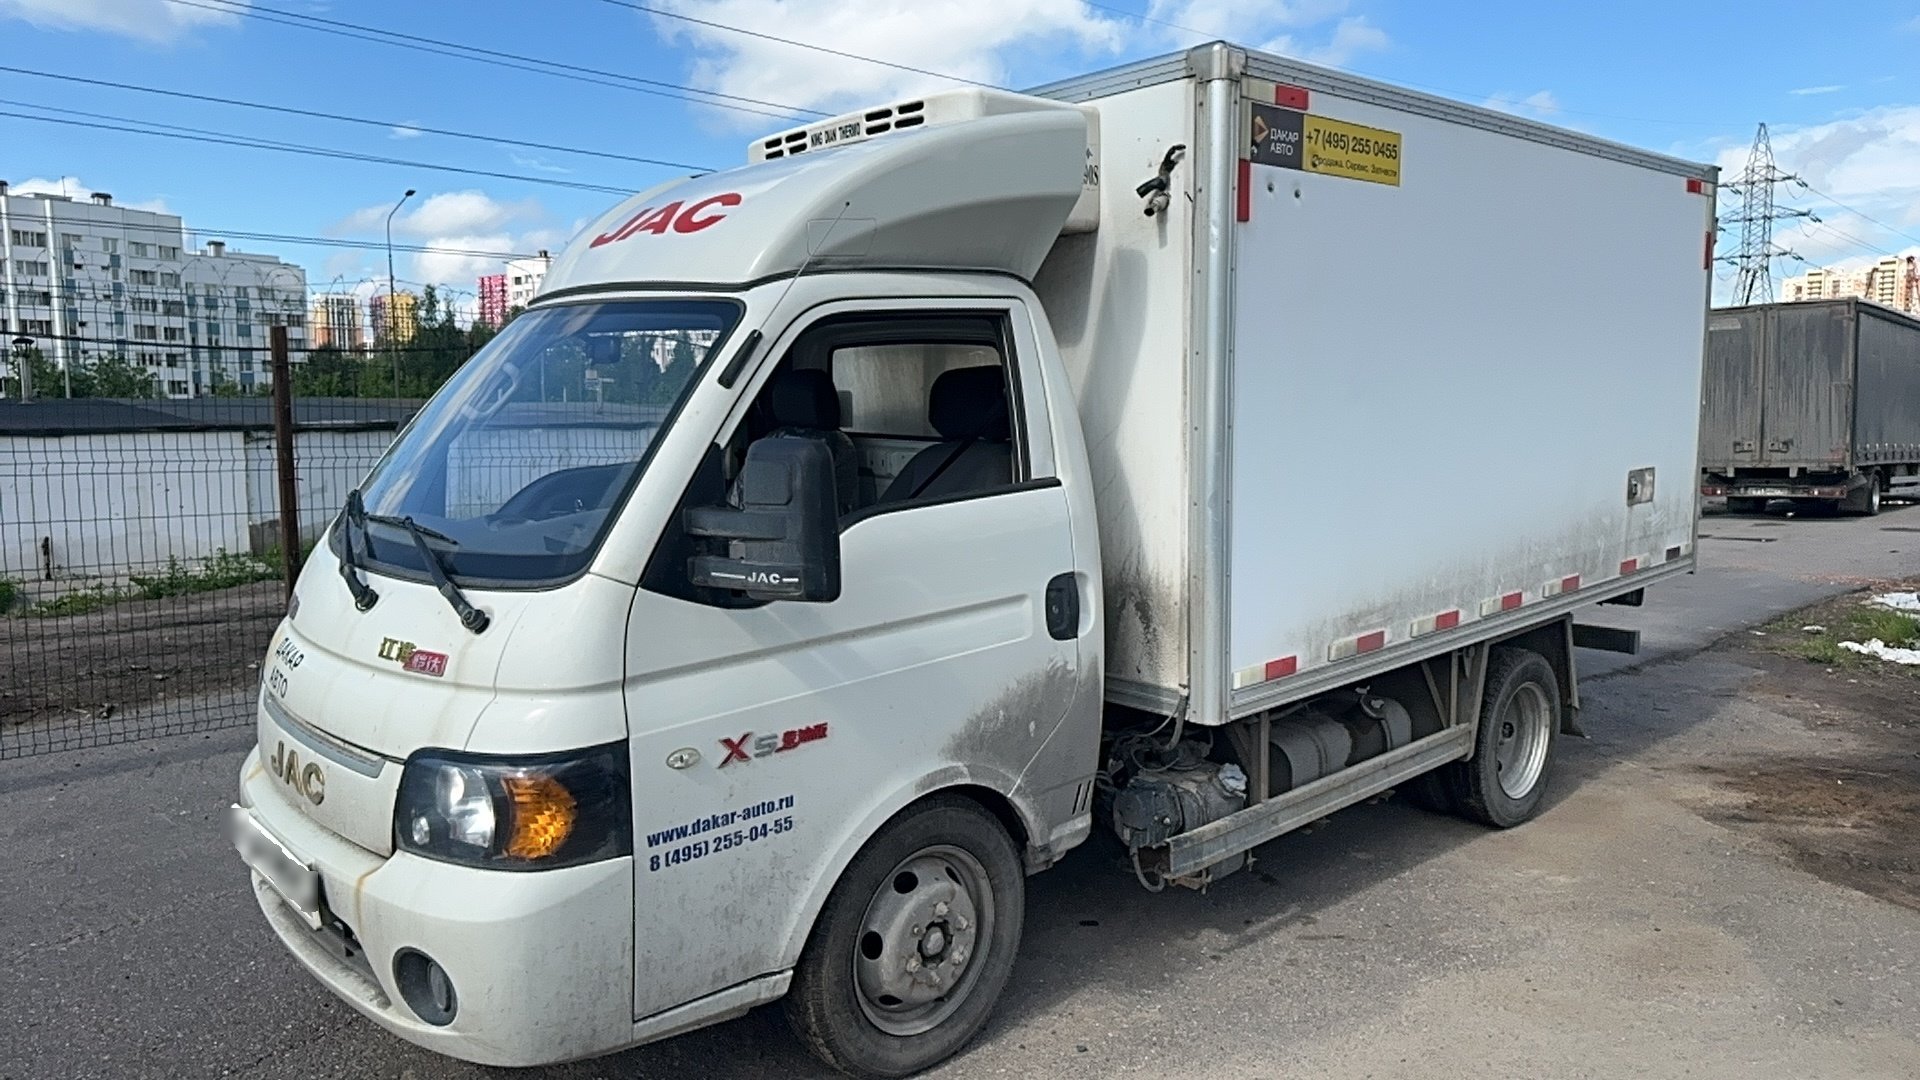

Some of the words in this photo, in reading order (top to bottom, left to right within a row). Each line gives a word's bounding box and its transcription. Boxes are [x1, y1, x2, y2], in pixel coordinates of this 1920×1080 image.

[1270, 128, 1299, 143] ДАКАР
[1270, 142, 1294, 156] АВТО
[1306, 129, 1321, 146] +7
[1322, 130, 1350, 155] (495)
[1352, 136, 1371, 155] 255
[1373, 141, 1398, 160] 0455
[589, 193, 742, 248] JAC
[747, 572, 780, 584] JAC
[275, 637, 305, 671] ДАКАР
[270, 665, 288, 698] АВТО
[271, 740, 325, 806] JAC
[647, 795, 794, 848] www.dakar-auto.ru
[649, 855, 661, 872] 8
[665, 842, 709, 867] (495)
[713, 816, 793, 853] 255-04-55
